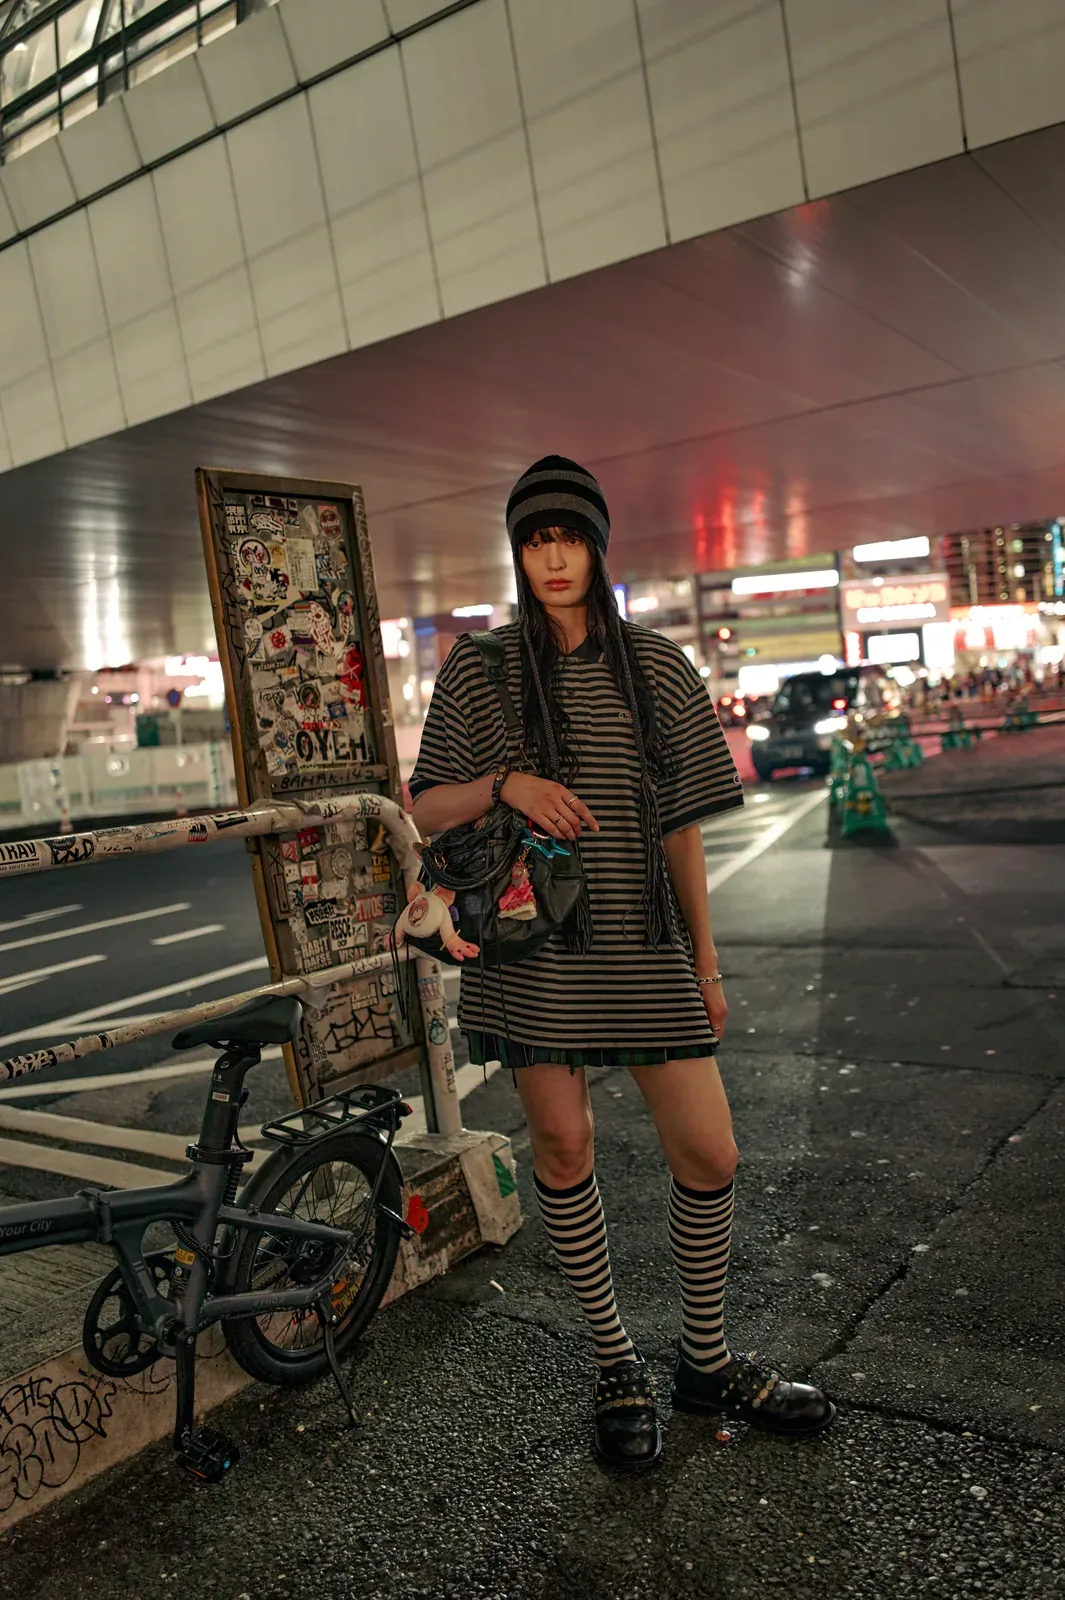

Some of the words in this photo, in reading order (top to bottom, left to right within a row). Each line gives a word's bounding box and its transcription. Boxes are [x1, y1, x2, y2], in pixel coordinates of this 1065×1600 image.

[301, 937, 328, 958] HABIT
[0, 1225, 28, 1238] Your
[30, 1219, 53, 1232] City
